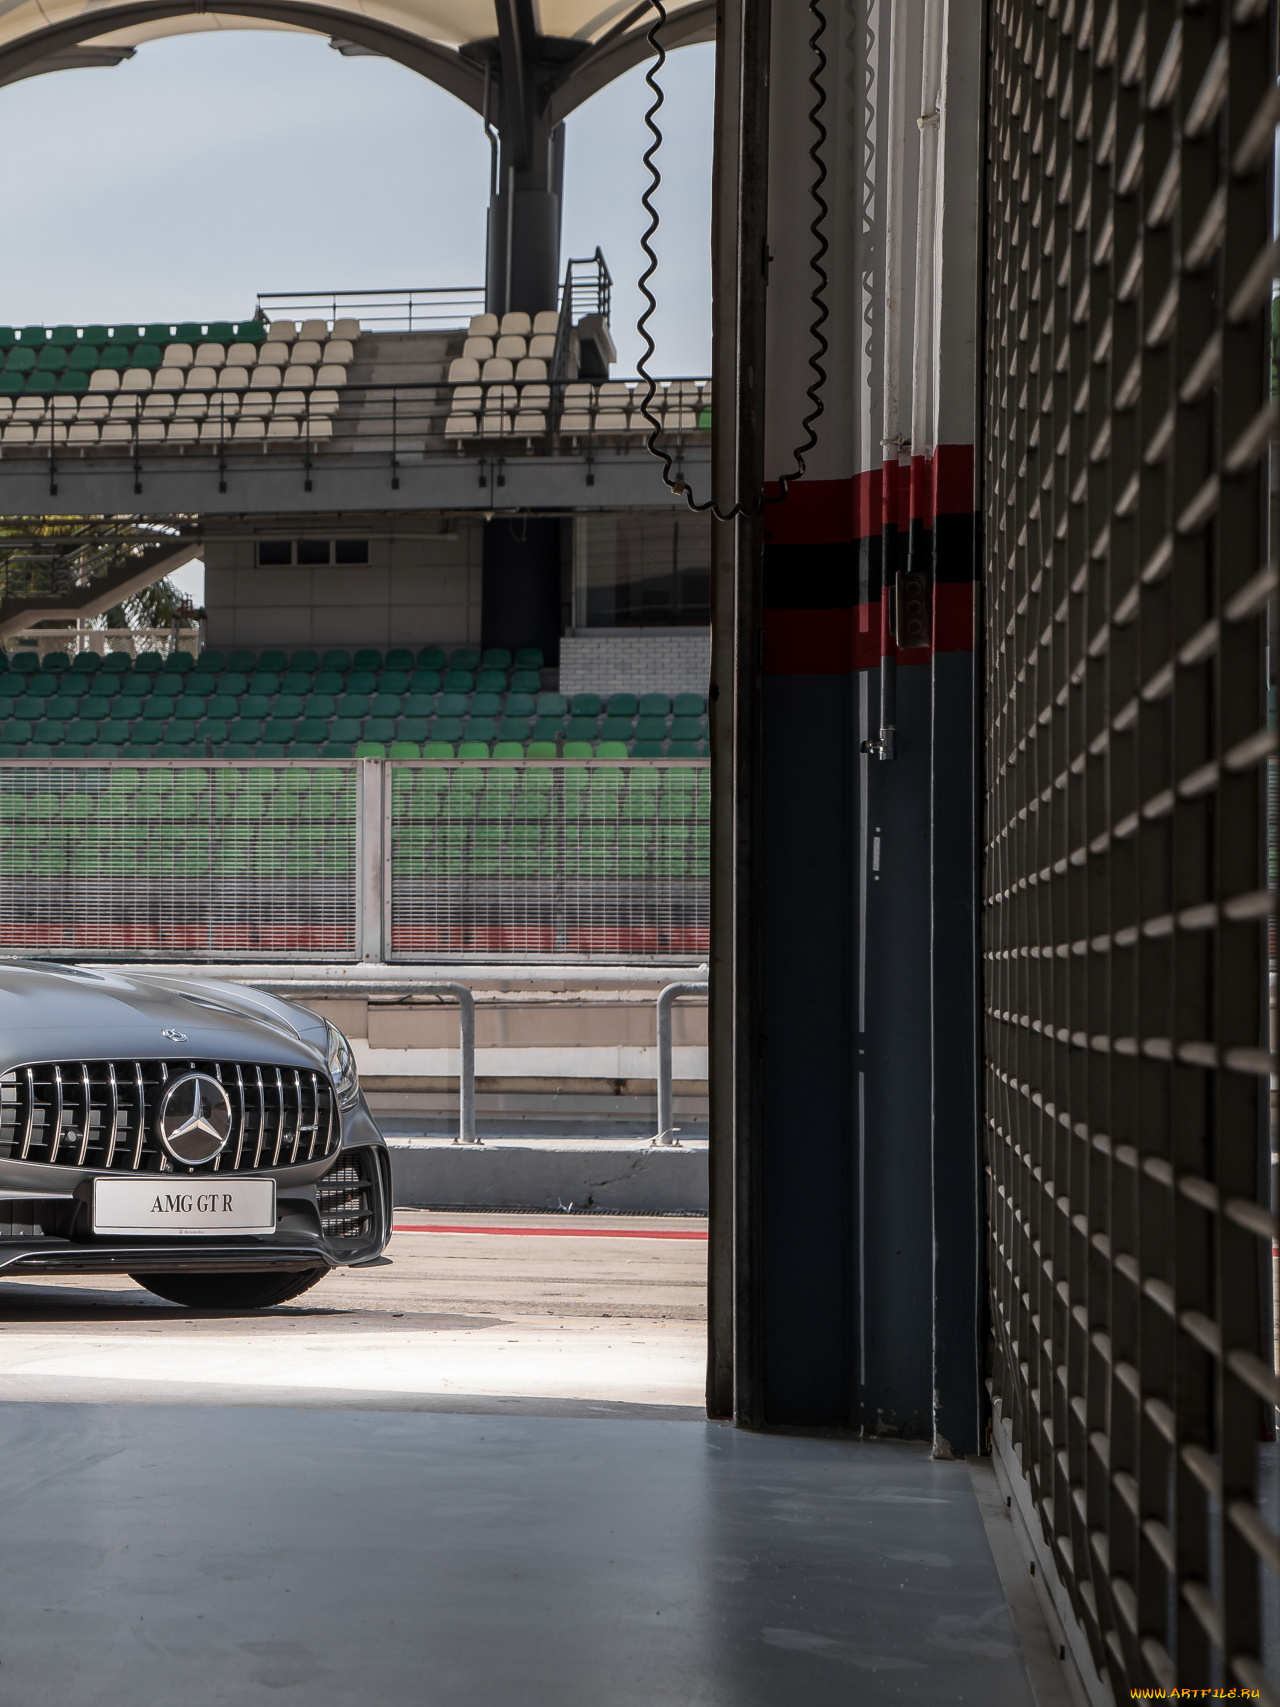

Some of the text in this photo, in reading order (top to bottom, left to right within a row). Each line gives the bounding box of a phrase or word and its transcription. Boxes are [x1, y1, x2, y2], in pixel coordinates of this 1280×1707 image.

[150, 1193, 234, 1214] AMG GT R
